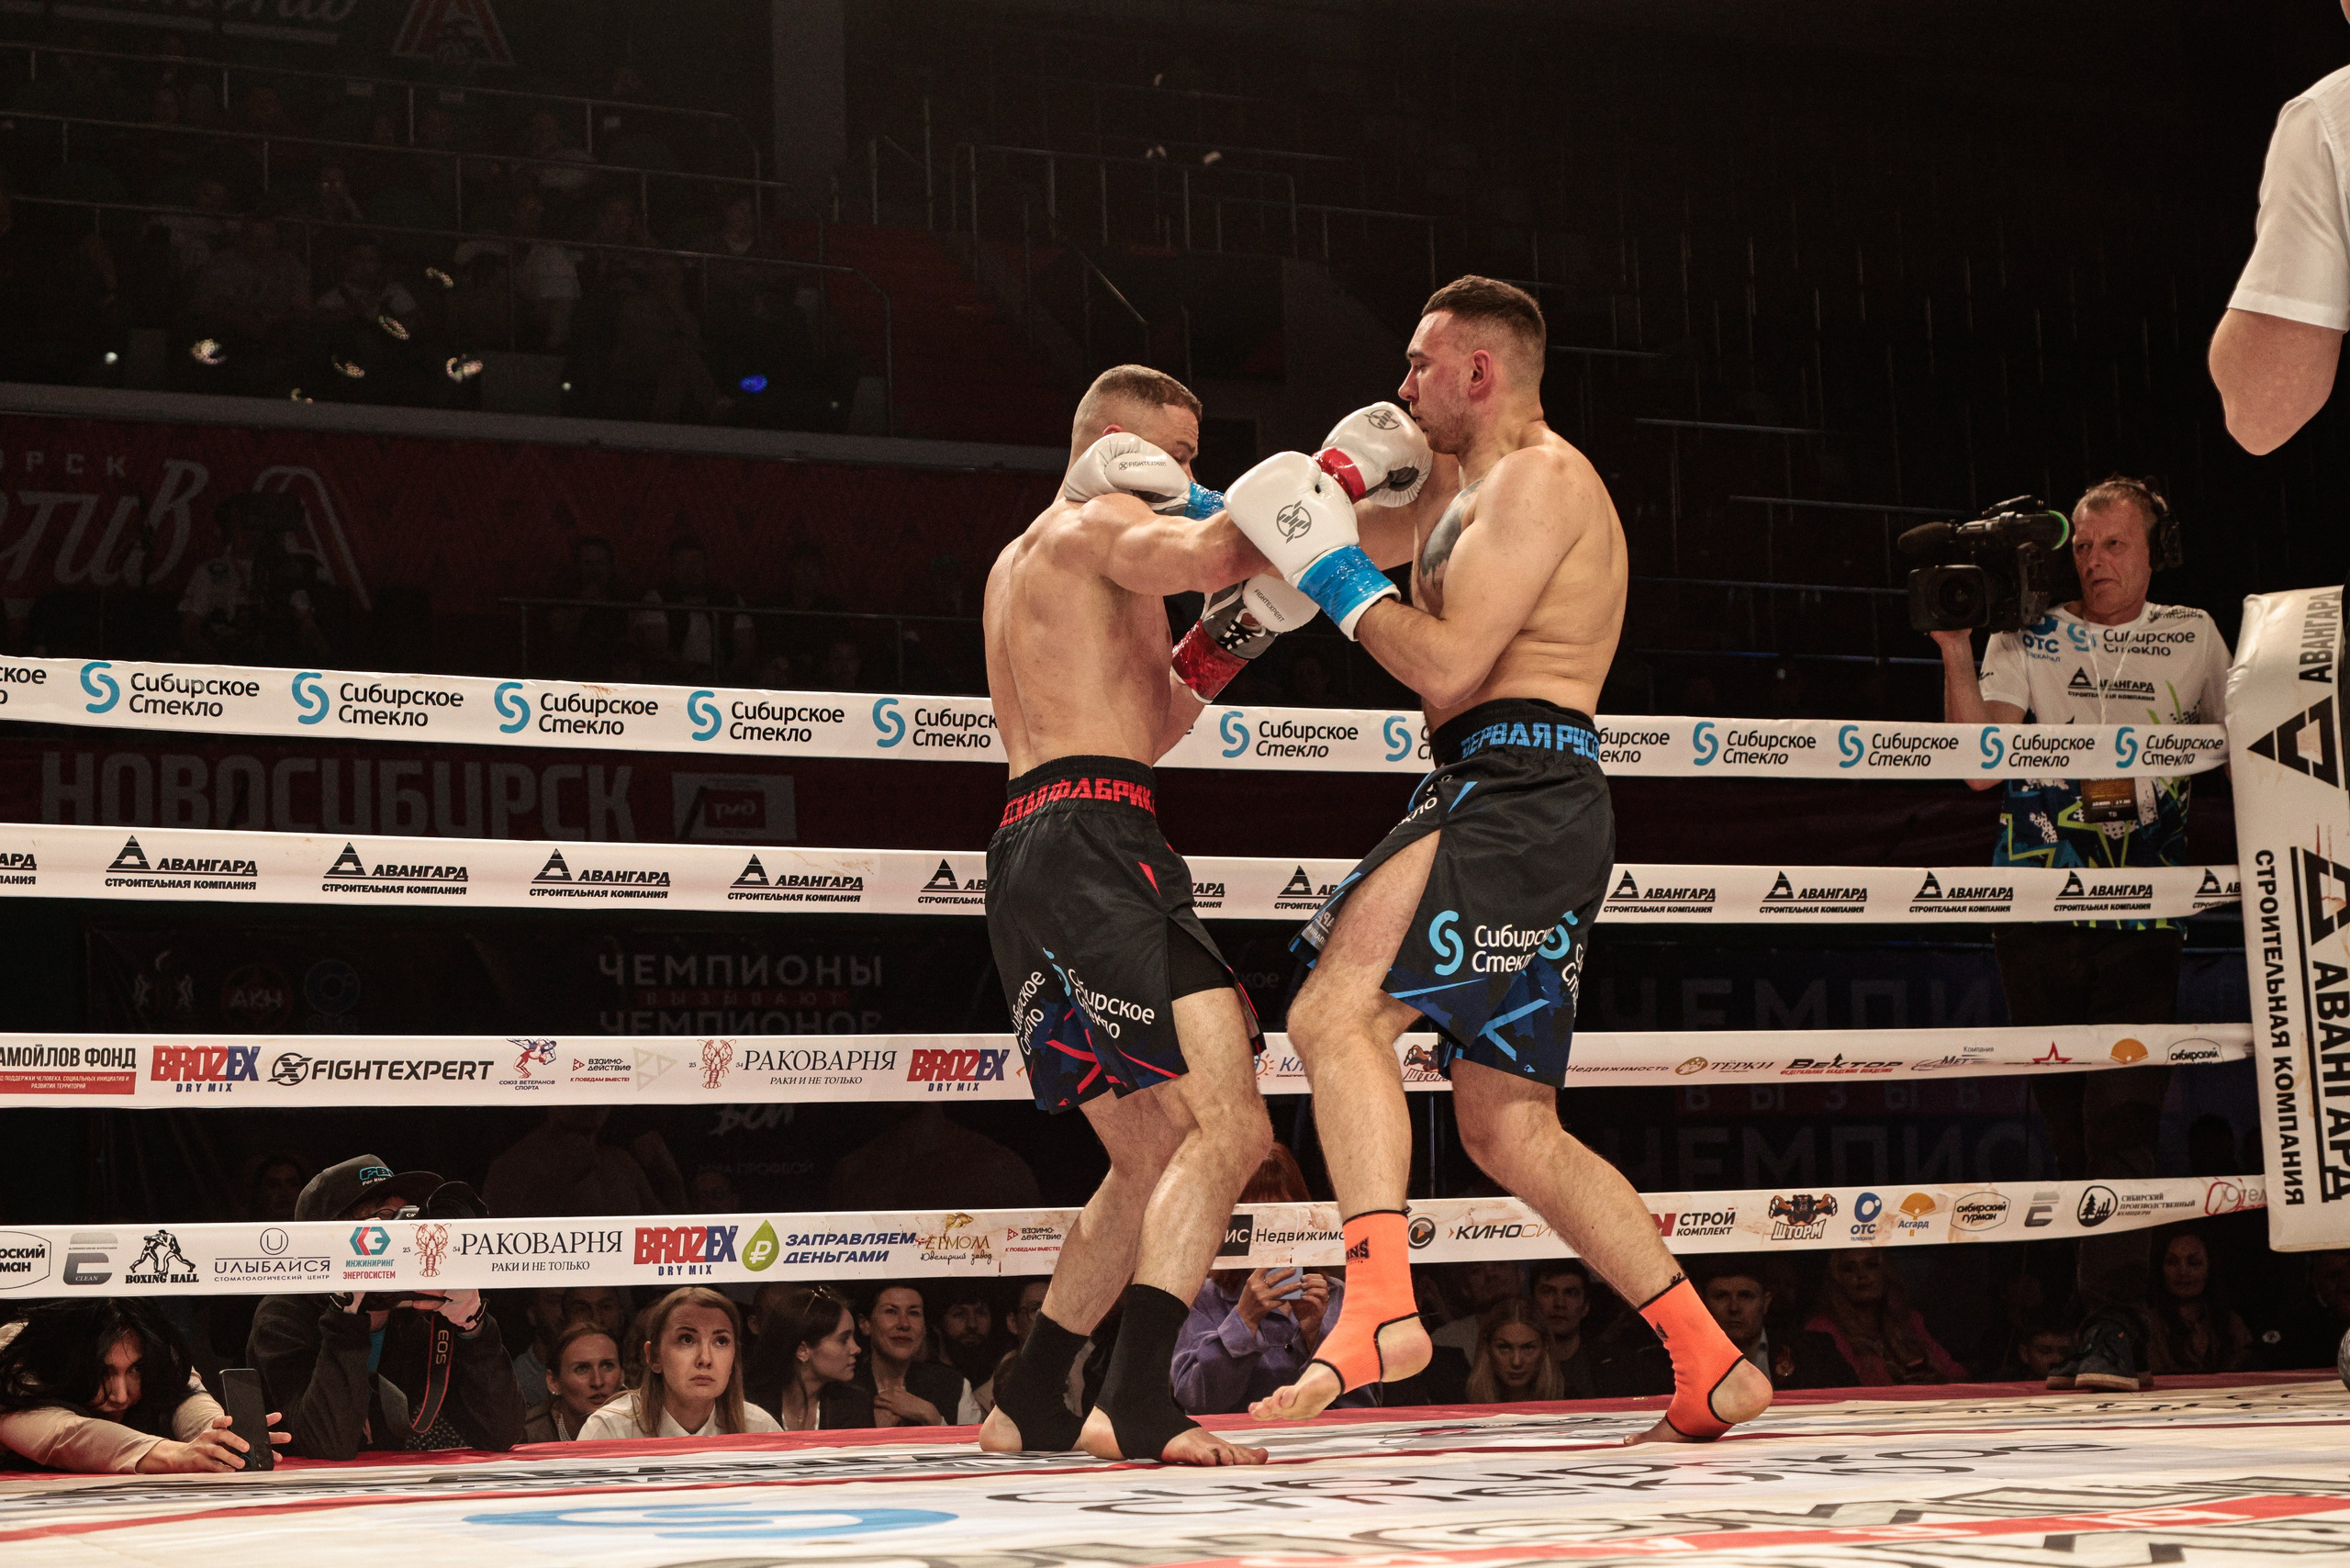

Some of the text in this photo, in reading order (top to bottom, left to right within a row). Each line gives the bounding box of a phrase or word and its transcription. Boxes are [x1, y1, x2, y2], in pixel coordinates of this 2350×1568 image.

[1252, 588, 1285, 623] FIGHTEXPERT
[2299, 589, 2341, 683] АВАНГАРД
[131, 673, 260, 699] Сибирское
[341, 683, 464, 709] Сибирское
[129, 694, 223, 717] Стекло
[541, 693, 658, 718] Сибирское
[732, 701, 845, 725] Сибирское
[339, 705, 428, 727] Стекло
[539, 714, 624, 735] Стекло
[730, 722, 811, 743] Стекло
[912, 729, 990, 748] Стекло
[1259, 721, 1359, 743] Сибирское
[1256, 740, 1329, 757] Стекло
[1728, 731, 1817, 751] Сибирское
[1873, 733, 1959, 753] Сибирское
[2012, 734, 2095, 754] Сибирское
[2146, 734, 2224, 754] Сибирское
[1723, 748, 1788, 765] Стекло
[1869, 751, 1931, 767] Стекло
[2009, 753, 2070, 767] Стекло
[2143, 751, 2196, 767] Стекло
[157, 857, 258, 875] АВАНГАРД
[373, 864, 468, 881] АВАНГАРД
[105, 879, 256, 890] СТРОИТЕЛЬНАЯ КОМПАНИЯ
[578, 869, 670, 887] АВАНГАРД
[775, 874, 863, 891] АВАНГАРД
[322, 884, 467, 895] СТРОИТЕЛЬНАЯ КОМПАНИЯ
[530, 889, 668, 899] СТРОИТЕЛЬНАЯ КОМПАНИЯ
[728, 892, 861, 902] СТРОИТЕЛЬНАЯ КОМПАНИЯ
[1643, 889, 1716, 902] АВАНГАРД
[1797, 889, 1867, 902] АВАНГАРД
[1947, 887, 2013, 900] АВАНГАРД
[2088, 885, 2153, 898] АВАНГАРД
[599, 955, 881, 986] ЧЕМПИОНЫ
[2255, 849, 2305, 1205] СТРОИТЕЛЬНАЯ КОМПАНИЯ
[84, 1048, 137, 1069] ФОНД
[151, 1046, 261, 1082] BROZEX
[744, 1050, 898, 1070] РАКОВАРНЯ
[907, 1049, 1010, 1081] BROZEX
[312, 1060, 494, 1081] FIGHTEXPERT
[176, 1083, 232, 1092] DRY MIX
[928, 1083, 979, 1092] DRY MIX
[2120, 1201, 2196, 1209] ПРОИЗВОДСТВЕННЫЙ
[2121, 1193, 2165, 1202] СИБИРСКИЙ
[1680, 1207, 1736, 1226] СТРОЙ
[1956, 1201, 2008, 1217] сибирский
[1898, 1221, 1930, 1229] Асгард
[1962, 1212, 1997, 1224] гурман
[1676, 1226, 1732, 1237] КОМПЛЕКТ
[1771, 1218, 1827, 1240] ШТОРМ
[1851, 1224, 1876, 1235] ОТС
[461, 1231, 622, 1255] РАКОВАРНЯ
[633, 1226, 738, 1264] BROZEX
[786, 1233, 916, 1247] ЗАПРАВЛЯЕМ
[346, 1260, 395, 1268] ИНЖИНИРИНГ
[783, 1250, 890, 1264] ДЕНЬГАМИ
[492, 1261, 590, 1271] РАКИ И НЕ ТОЛЬКО
[658, 1265, 711, 1276] DRY MIX
[126, 1274, 199, 1284] BOXING HALL
[343, 1271, 396, 1280] ЭНЕРГОСИСТЕМ
[436, 1329, 449, 1365] EOS
